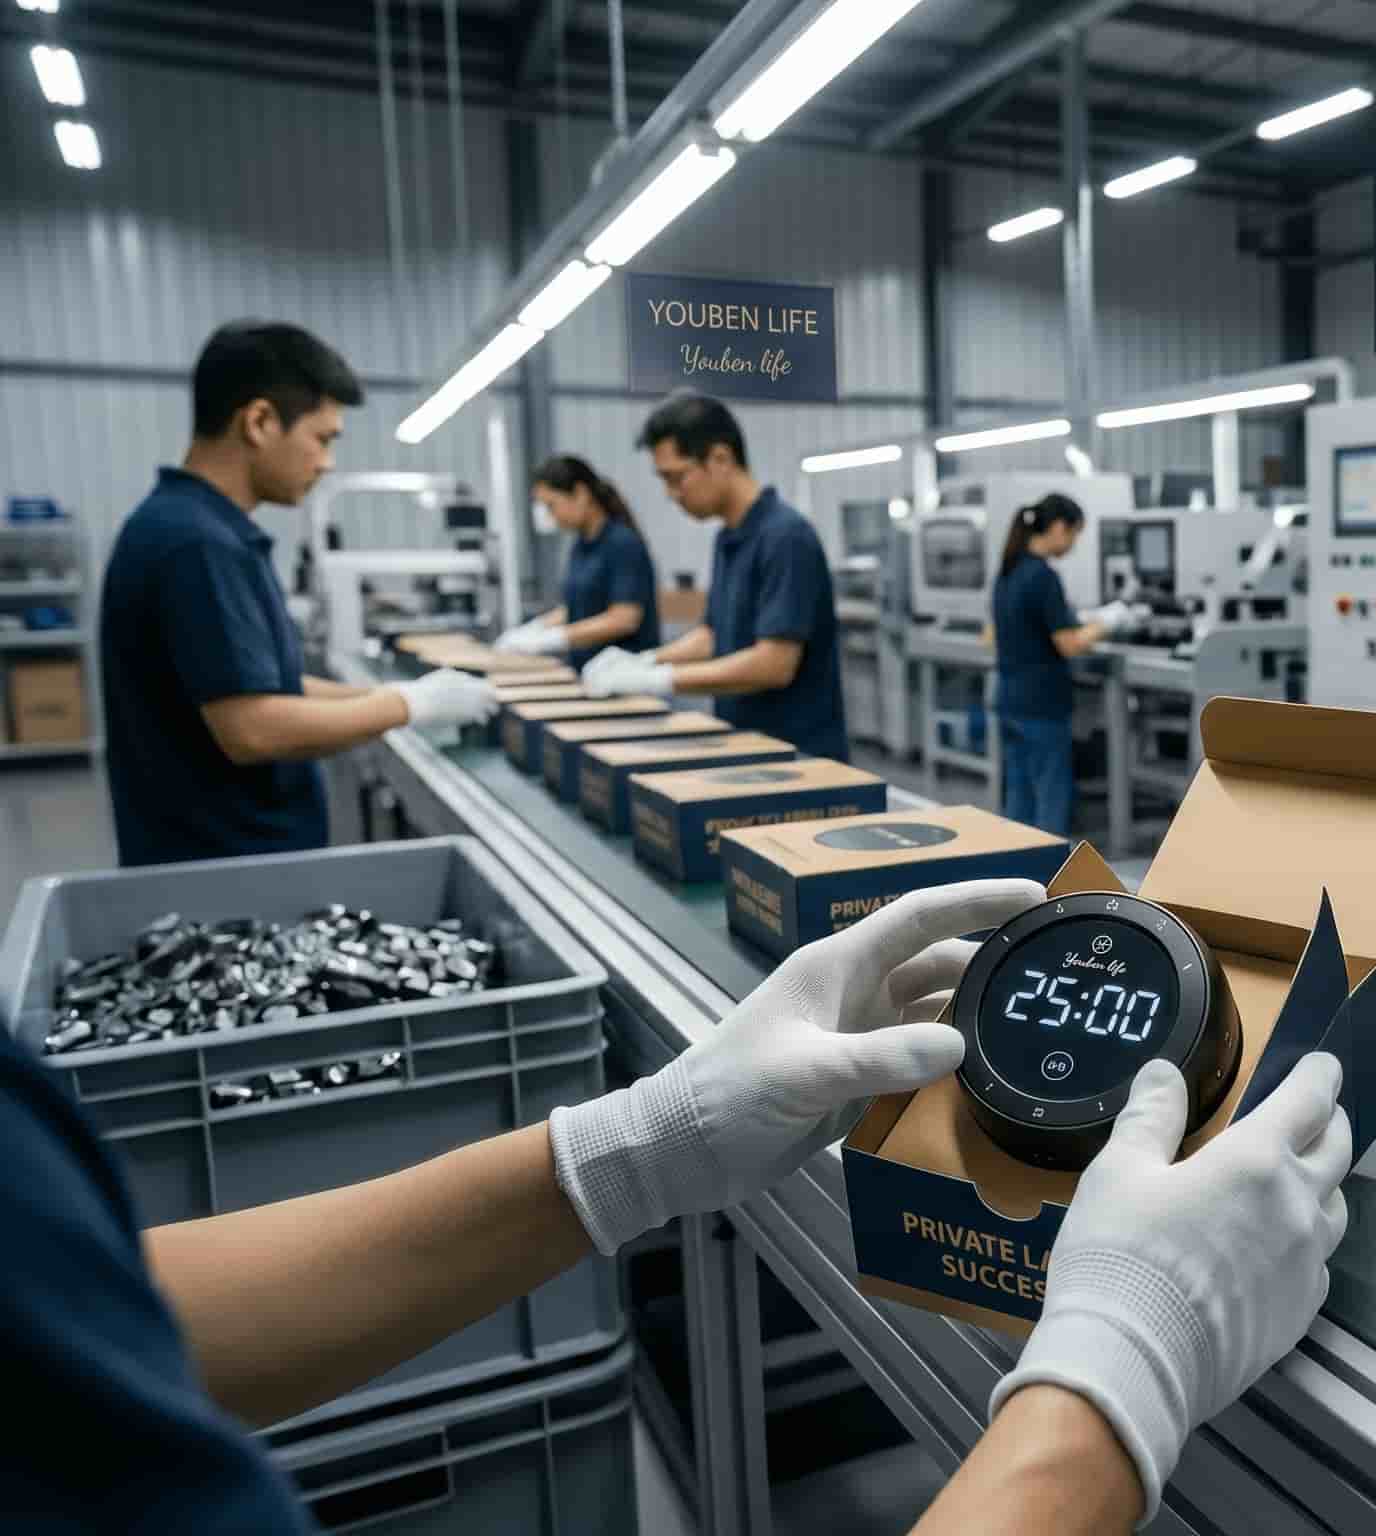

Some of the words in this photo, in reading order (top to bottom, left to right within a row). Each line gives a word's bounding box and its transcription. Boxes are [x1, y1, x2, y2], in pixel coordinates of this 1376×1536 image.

[648, 299, 760, 332] YOUBEN
[768, 307, 820, 336] LIFE
[680, 343, 754, 376] Youben
[760, 348, 793, 383] life
[1004, 968, 1162, 1042] 25:00
[902, 1212, 1017, 1264] PRIVATE
[941, 1254, 1047, 1303] SUCCES
